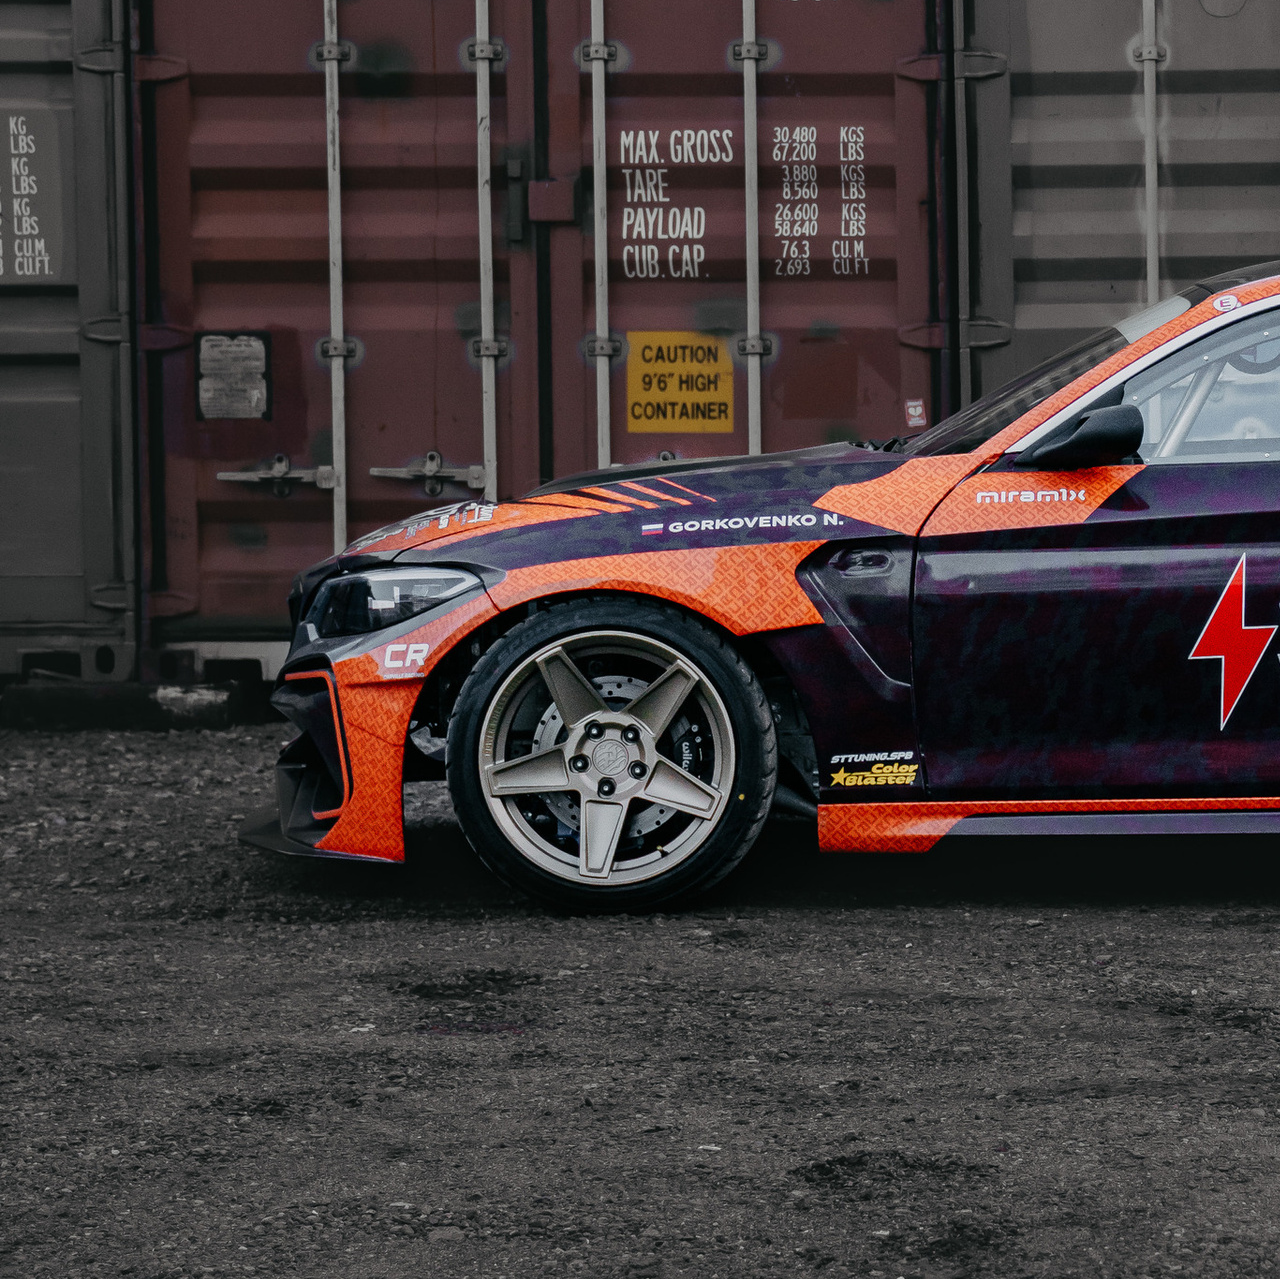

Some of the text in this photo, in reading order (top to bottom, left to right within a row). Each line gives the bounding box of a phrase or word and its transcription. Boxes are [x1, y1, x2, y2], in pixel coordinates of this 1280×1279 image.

[9, 116, 27, 135] KG
[773, 126, 865, 143] 30,480 KGS
[10, 135, 36, 154] LBS
[620, 129, 734, 164] MAX. GROSS
[772, 143, 865, 162] 67,200 LBS
[11, 157, 29, 176] KG
[841, 164, 865, 182] KGS
[12, 176, 38, 195] LBS
[622, 169, 670, 203] TARE
[842, 182, 866, 200] LBS
[13, 198, 31, 216] KG
[775, 203, 866, 221] 26,600 KGS
[14, 216, 39, 235] LBS
[622, 207, 706, 240] PAYLOAD
[774, 221, 866, 237] 58,640 LBS
[623, 244, 710, 279] CUB. CAP.
[641, 345, 719, 363] CAUTION
[678, 373, 719, 392] HIGH
[631, 402, 729, 420] CONTAINER
[668, 513, 844, 533] GORKOVENKO N.
[384, 643, 430, 668] CR
[830, 751, 914, 764] STTUNING.SPB
[871, 762, 919, 774] Color
[845, 774, 916, 787] Blaster
